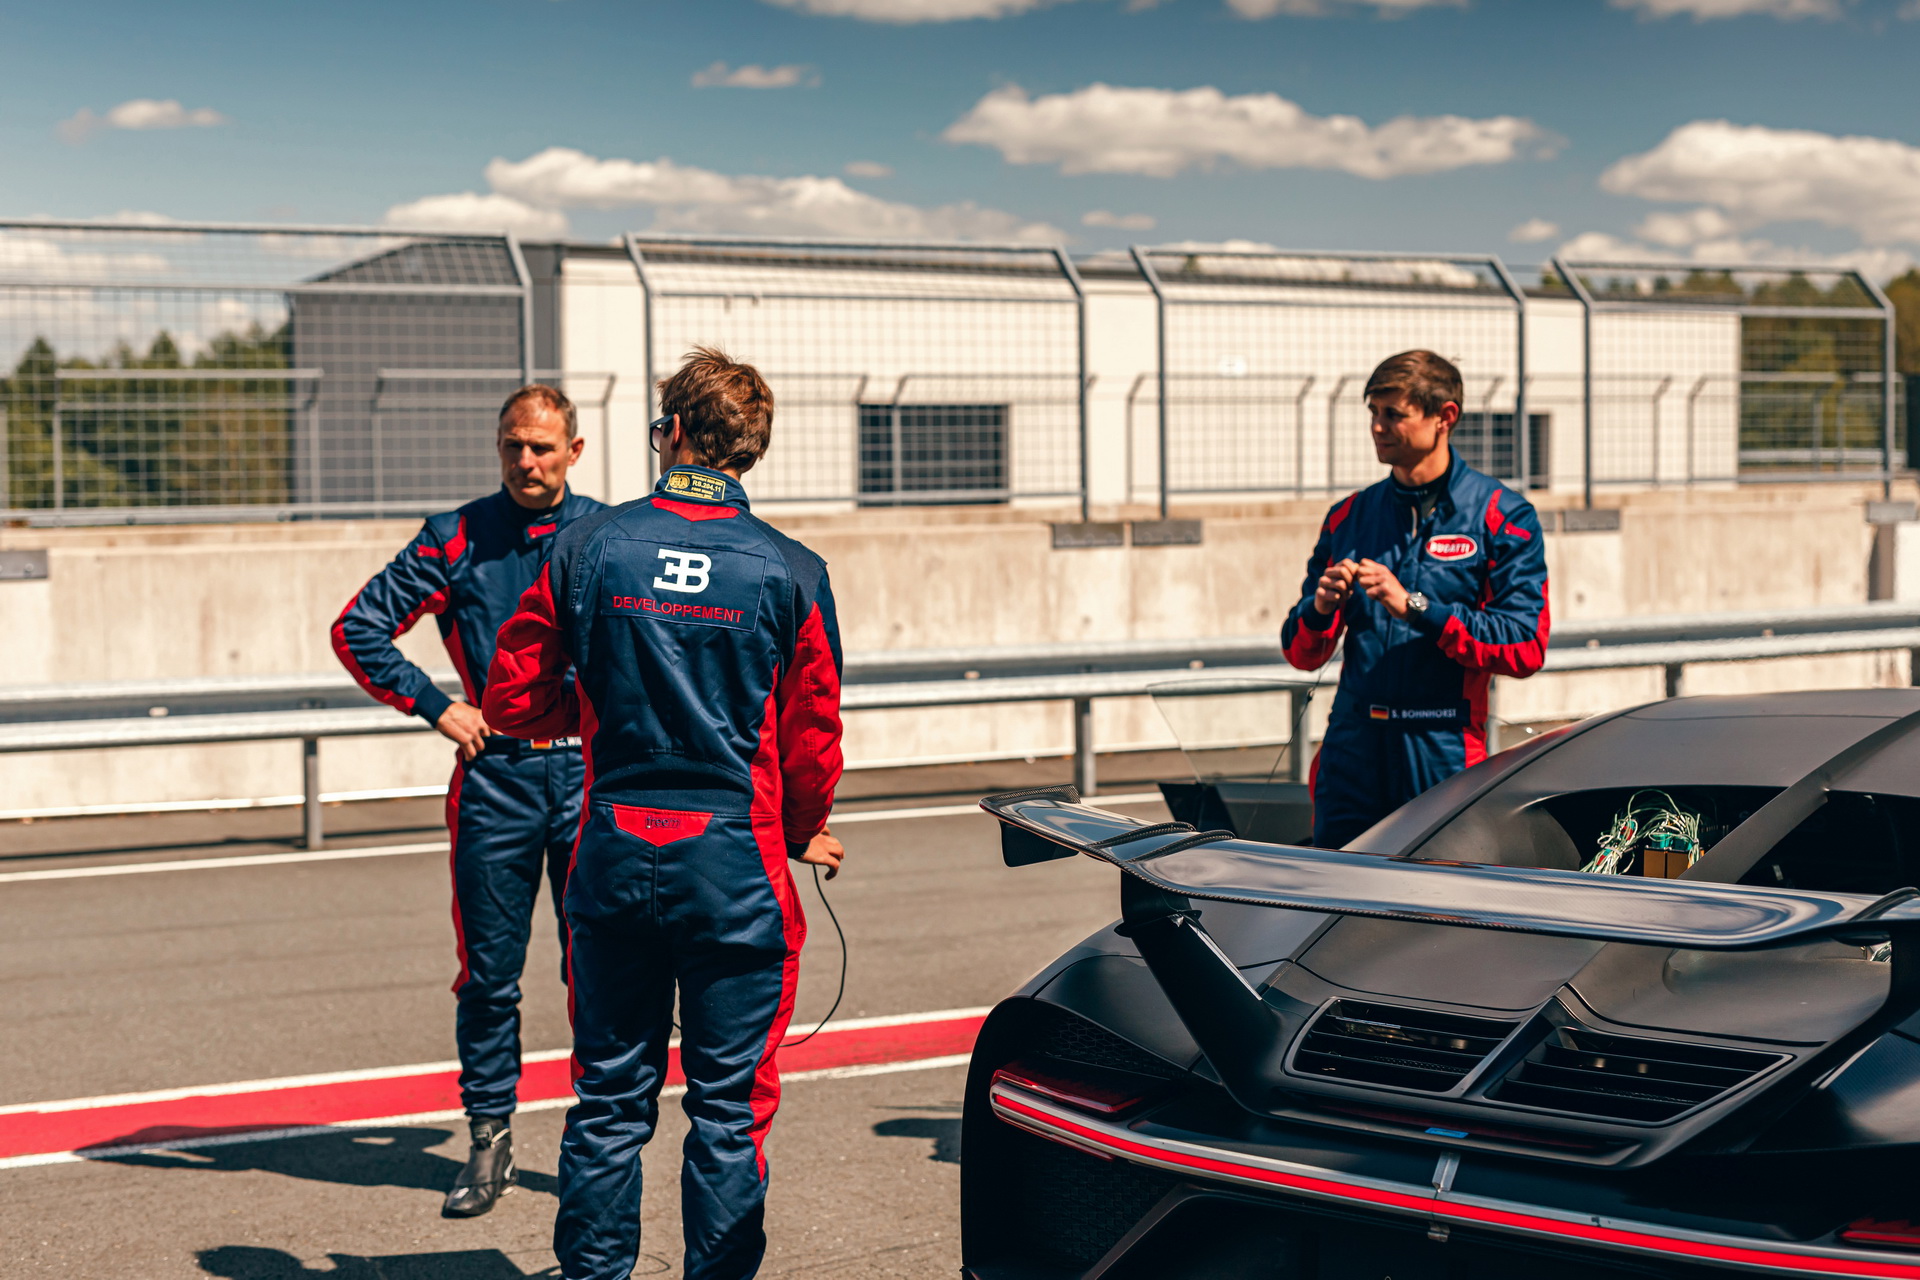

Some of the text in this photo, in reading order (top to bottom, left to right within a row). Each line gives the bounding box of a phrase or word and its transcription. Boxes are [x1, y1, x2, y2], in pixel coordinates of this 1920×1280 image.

[1430, 541, 1470, 554] BUGATTI
[612, 596, 744, 623] DEVELOPPEMENT
[1402, 708, 1456, 719] BOHNHORST
